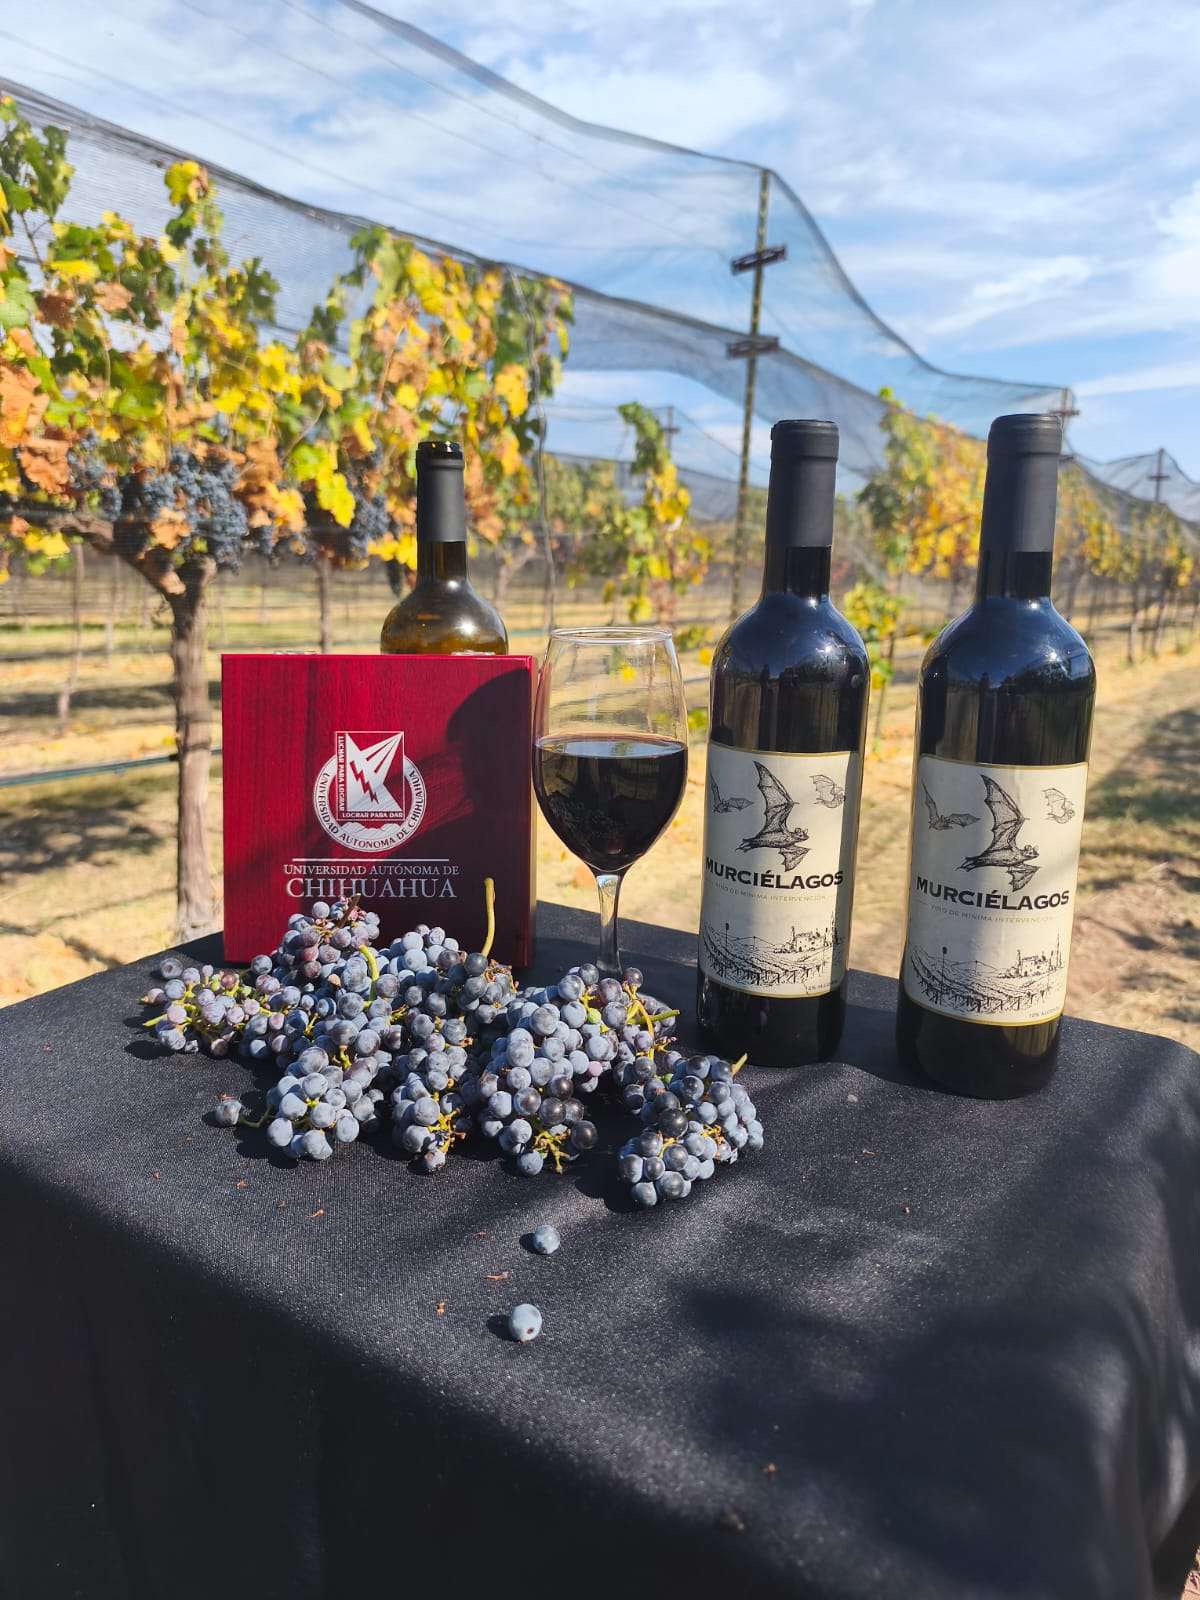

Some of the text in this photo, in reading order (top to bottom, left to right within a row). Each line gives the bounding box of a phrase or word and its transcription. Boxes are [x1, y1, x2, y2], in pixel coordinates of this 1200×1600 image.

[318, 770, 425, 849] UNIVERSIDAD AUTONOMA DE CHIHUAHUA
[284, 863, 459, 875] UNIVERSIDAD AUTÓNOMA DE
[705, 856, 844, 890] MURCIÉLAGOS
[286, 877, 458, 898] CHIHUAHUA
[916, 876, 1070, 911] MURCIÉLAGOS
